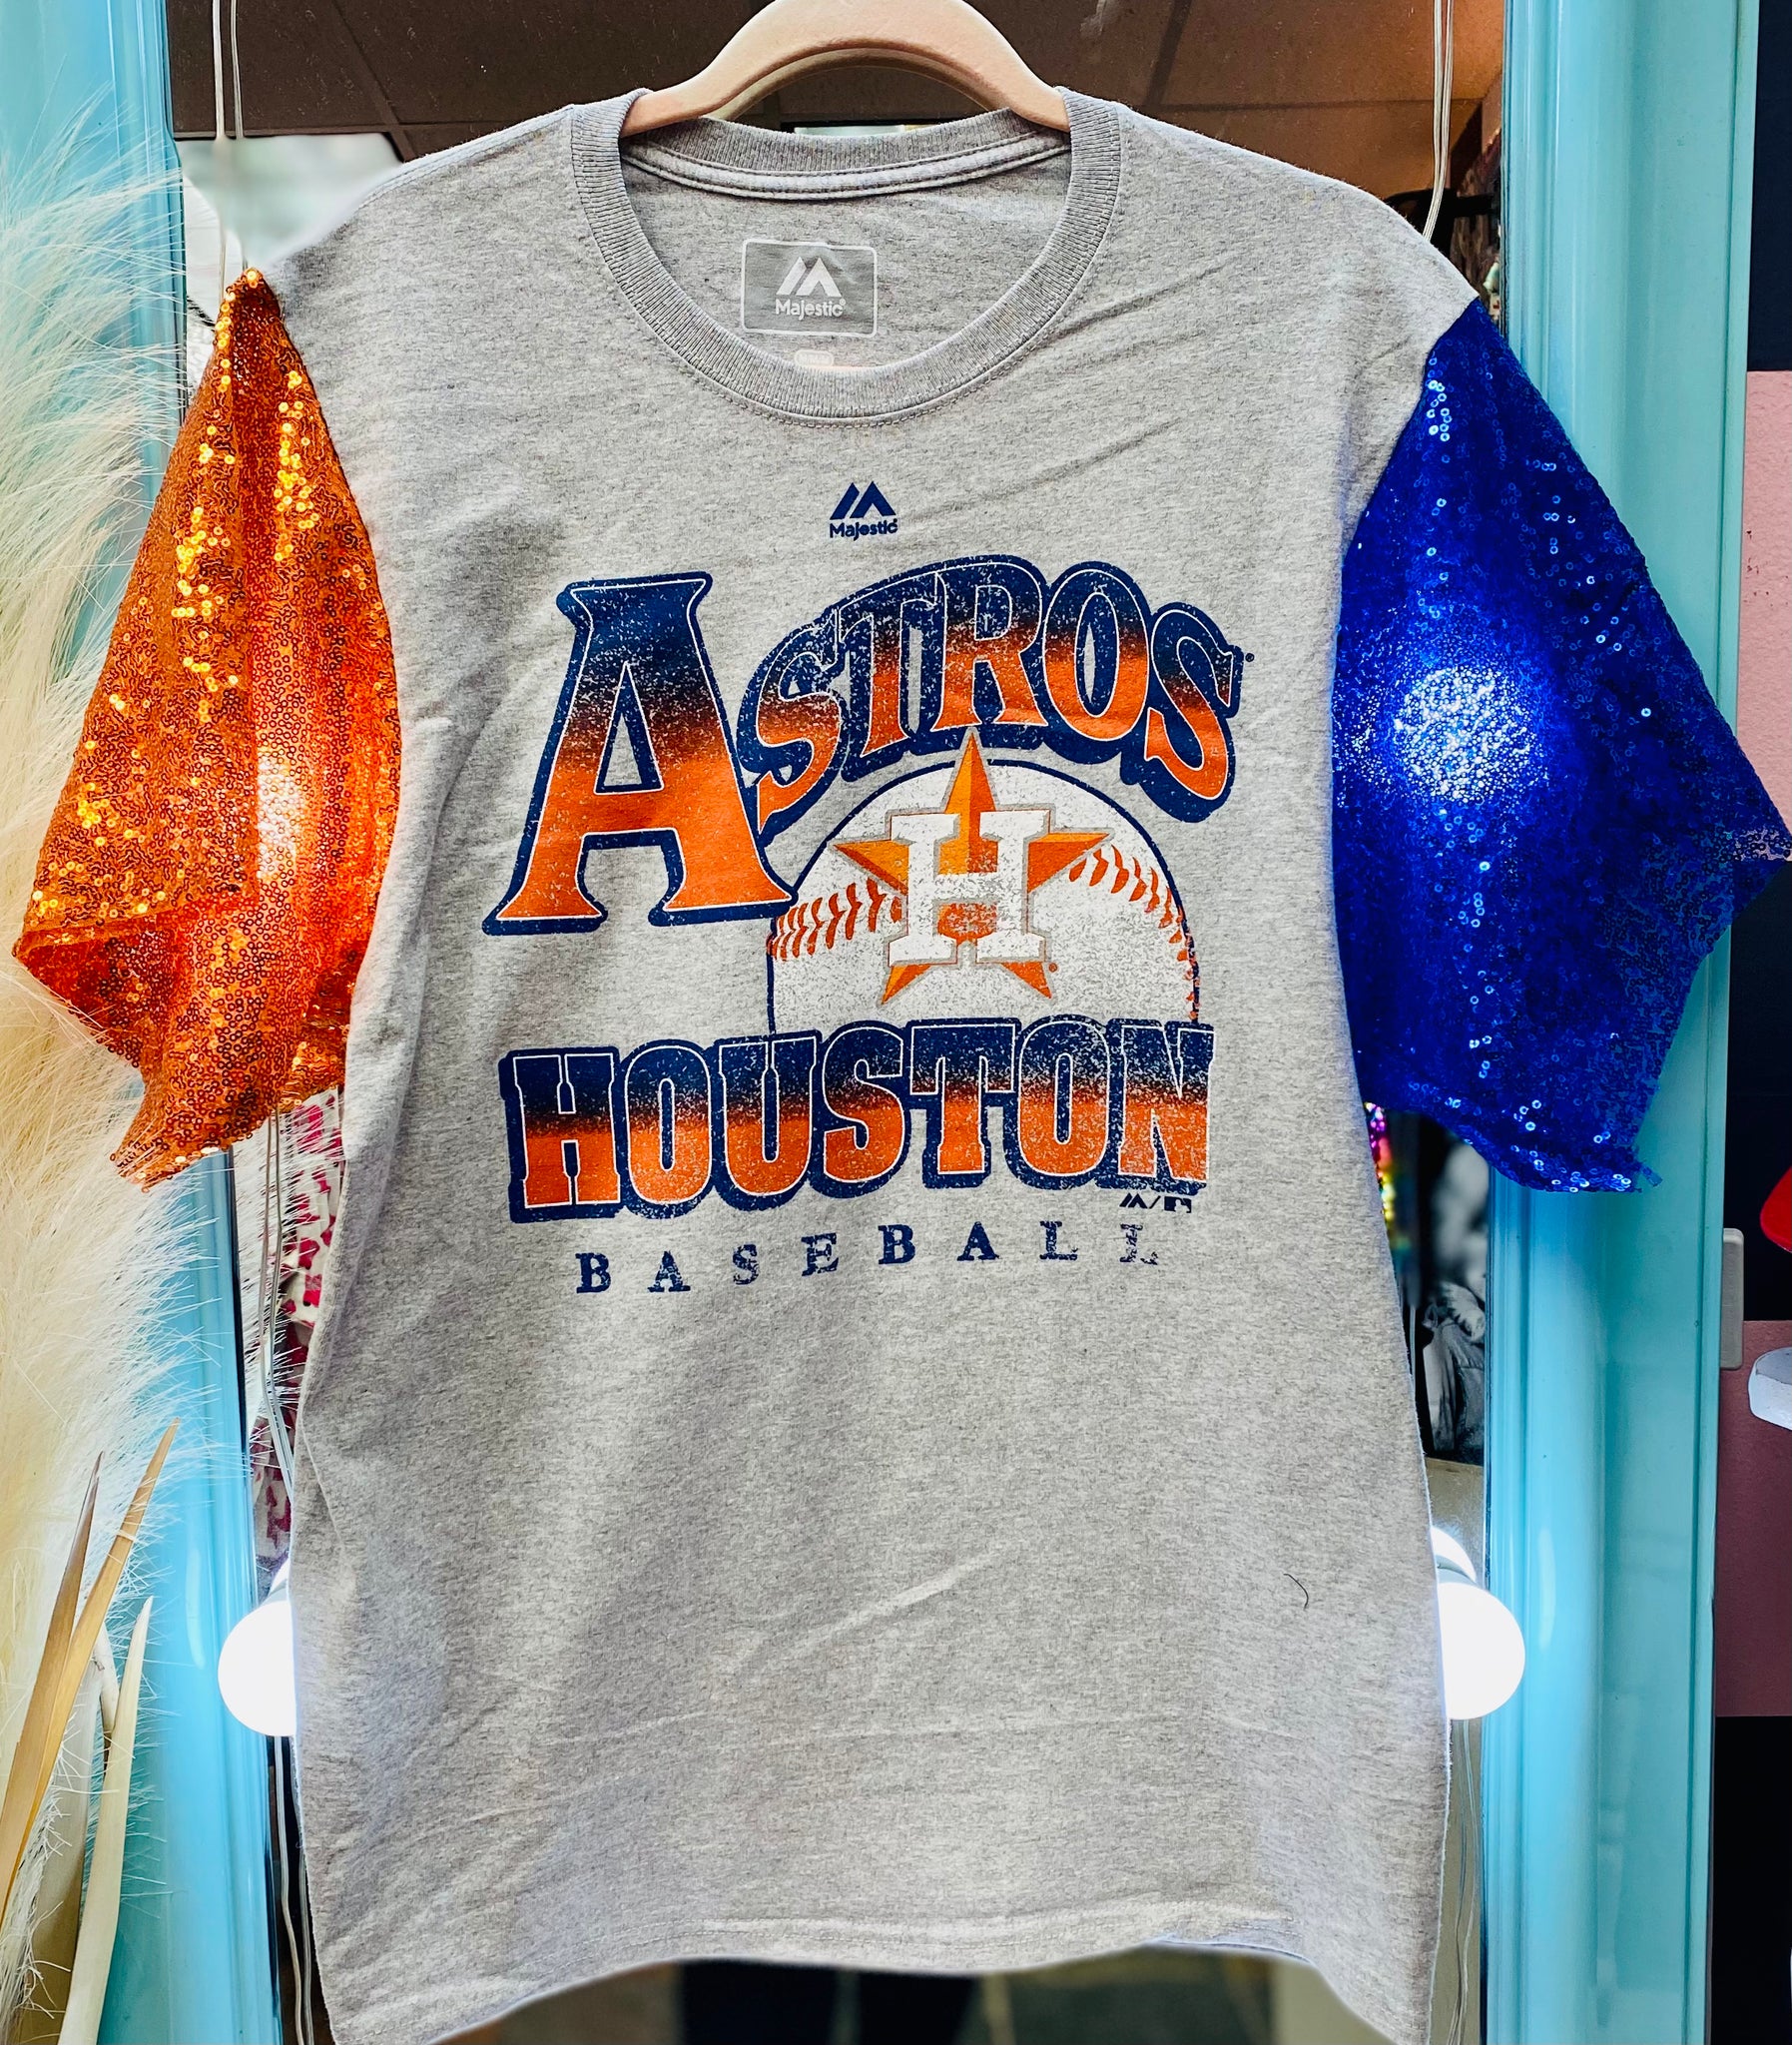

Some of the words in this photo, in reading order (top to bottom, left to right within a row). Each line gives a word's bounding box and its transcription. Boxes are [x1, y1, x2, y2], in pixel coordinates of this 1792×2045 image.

[775, 299, 847, 321] Majestic
[829, 518, 898, 542] Majestic
[888, 810, 1053, 967] H
[501, 1017, 1215, 1224] HOUSTON
